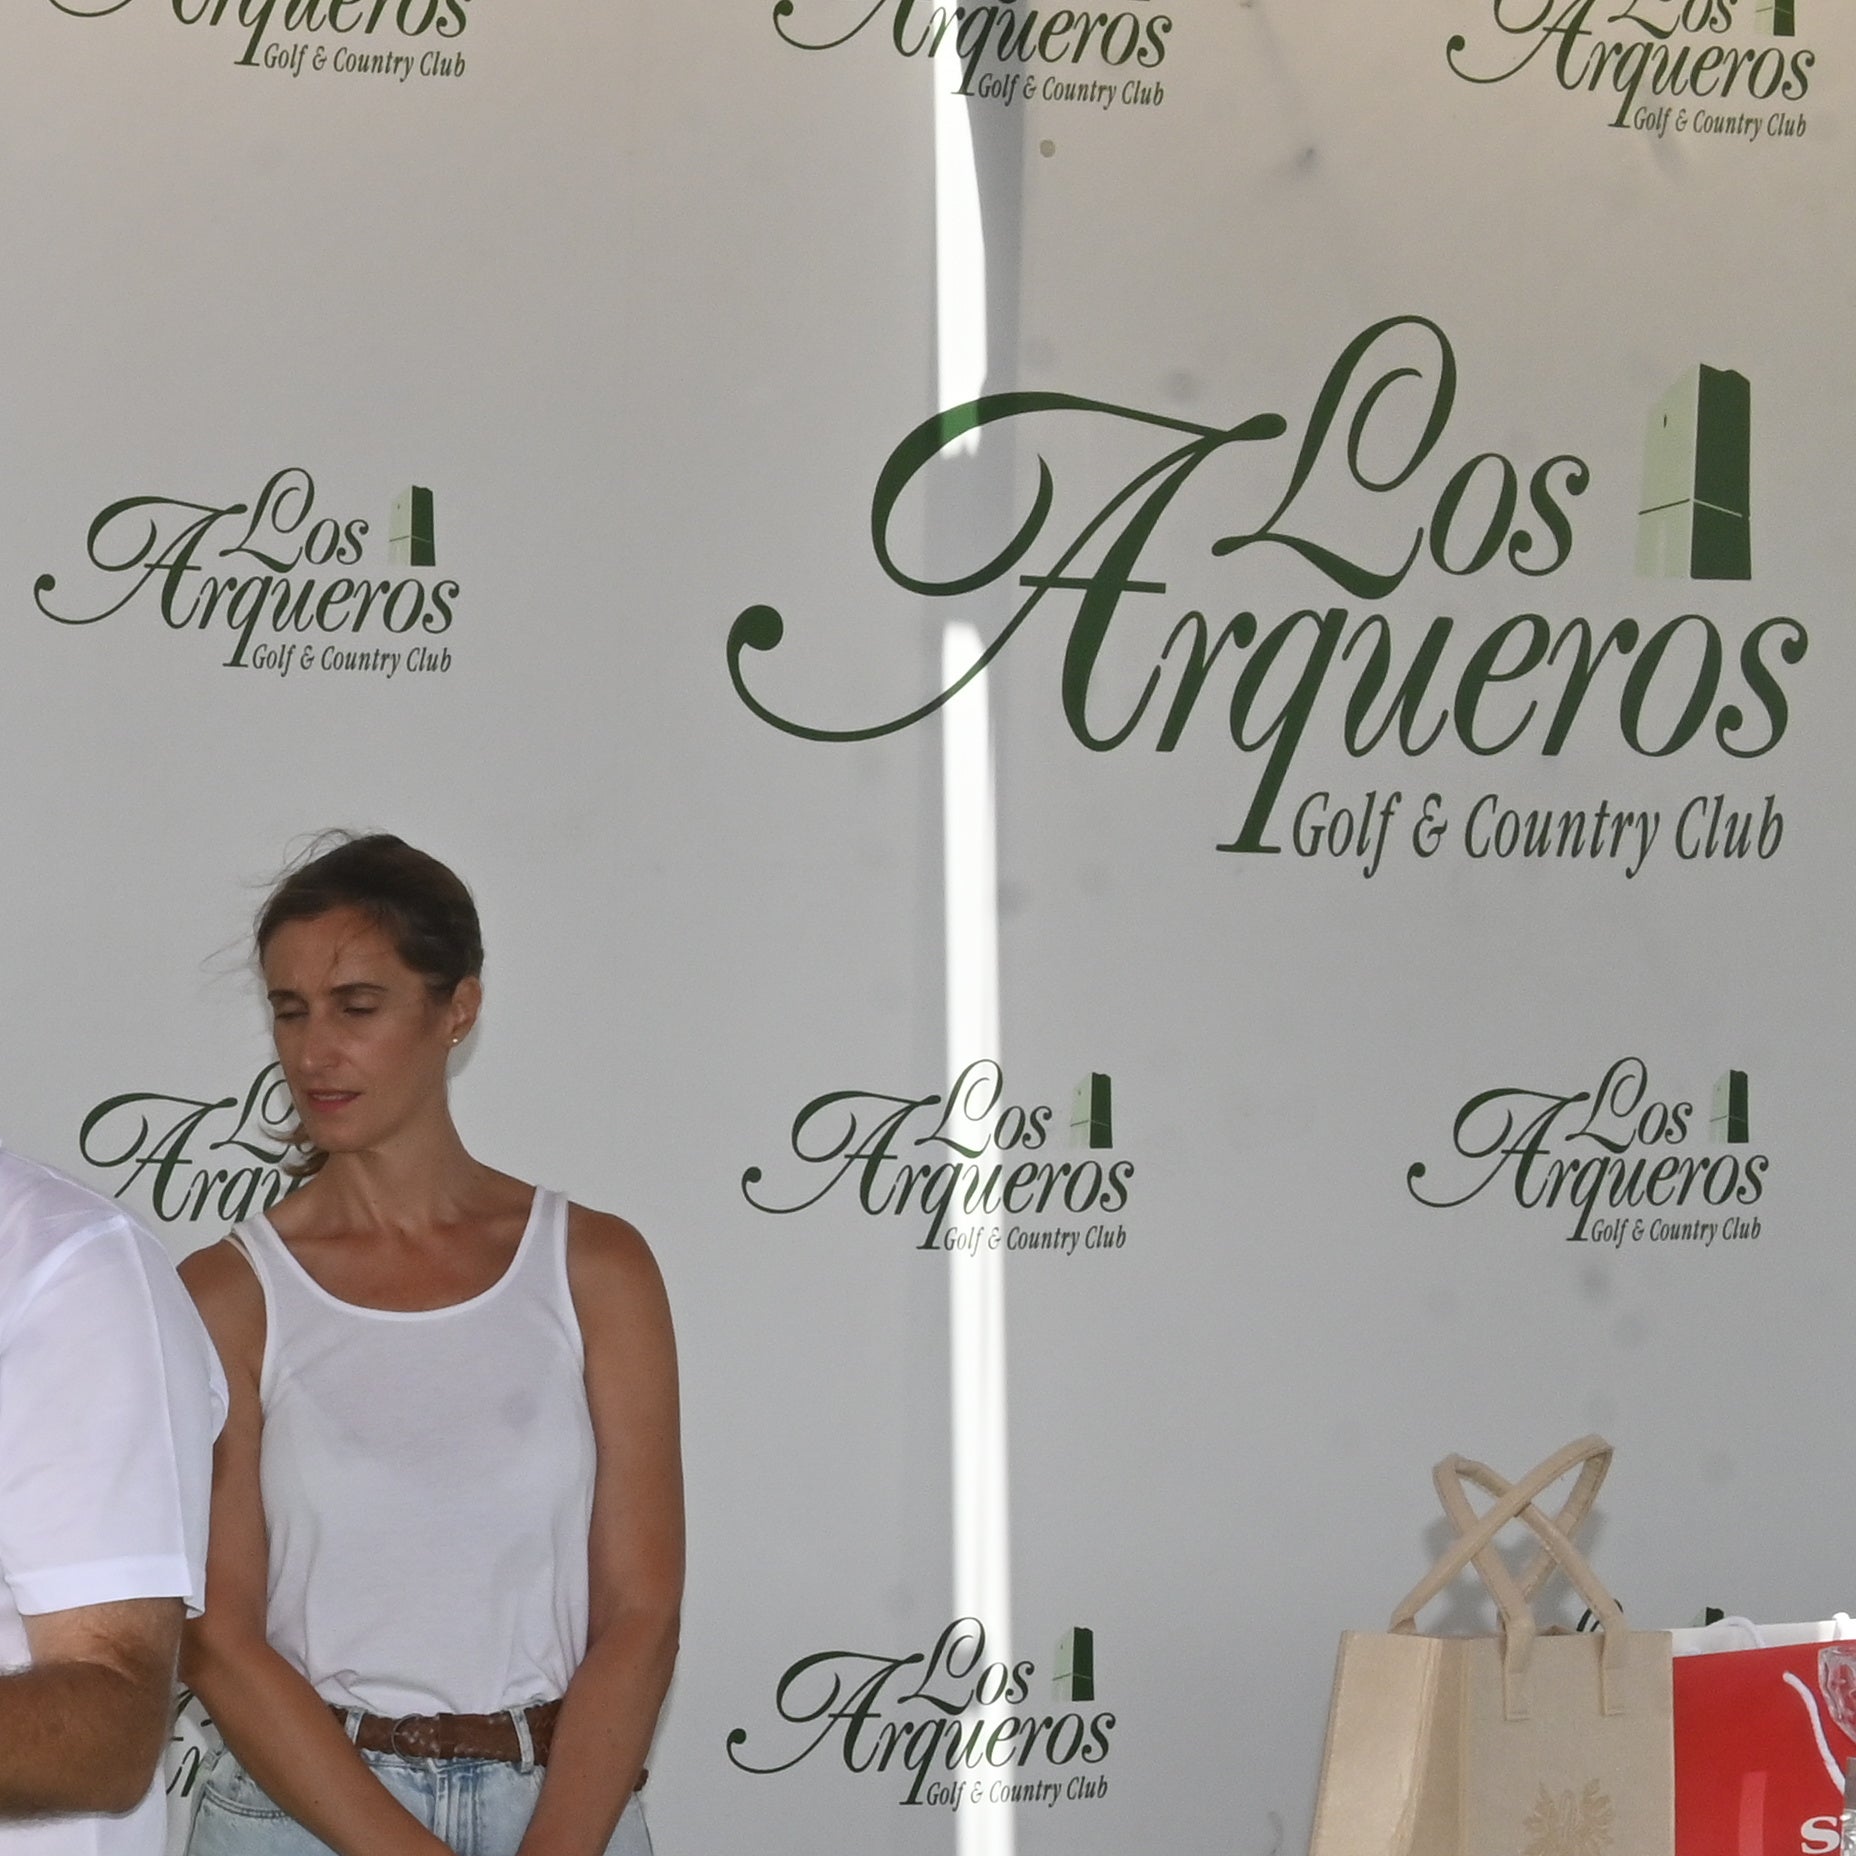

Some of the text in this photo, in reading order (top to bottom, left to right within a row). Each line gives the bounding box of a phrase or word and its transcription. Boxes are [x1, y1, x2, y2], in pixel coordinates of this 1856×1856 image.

[263, 42, 466, 83] Golf & Country Club
[977, 73, 1164, 110] Golf & Country Club
[1633, 105, 1807, 143] Golf & Country Club
[1211, 314, 1591, 600] Los
[219, 467, 370, 569] Los
[34, 496, 461, 670] Arqueros
[726, 390, 1808, 854] Arqueros
[252, 643, 452, 680] Golf & Country Club
[1292, 790, 1784, 880] Golf & Country Club
[927, 1059, 1053, 1160] Los
[1579, 1056, 1694, 1149] Los
[742, 1091, 1135, 1250] Arqueros
[1406, 1087, 1770, 1242] Arqueros
[944, 1224, 1127, 1257] Golf & Country Club
[1591, 1216, 1762, 1250] Golf & Country Club
[910, 1618, 1036, 1717] Los
[726, 1651, 1116, 1805] Arqueros
[927, 1774, 1108, 1813] Golf & Country Club
